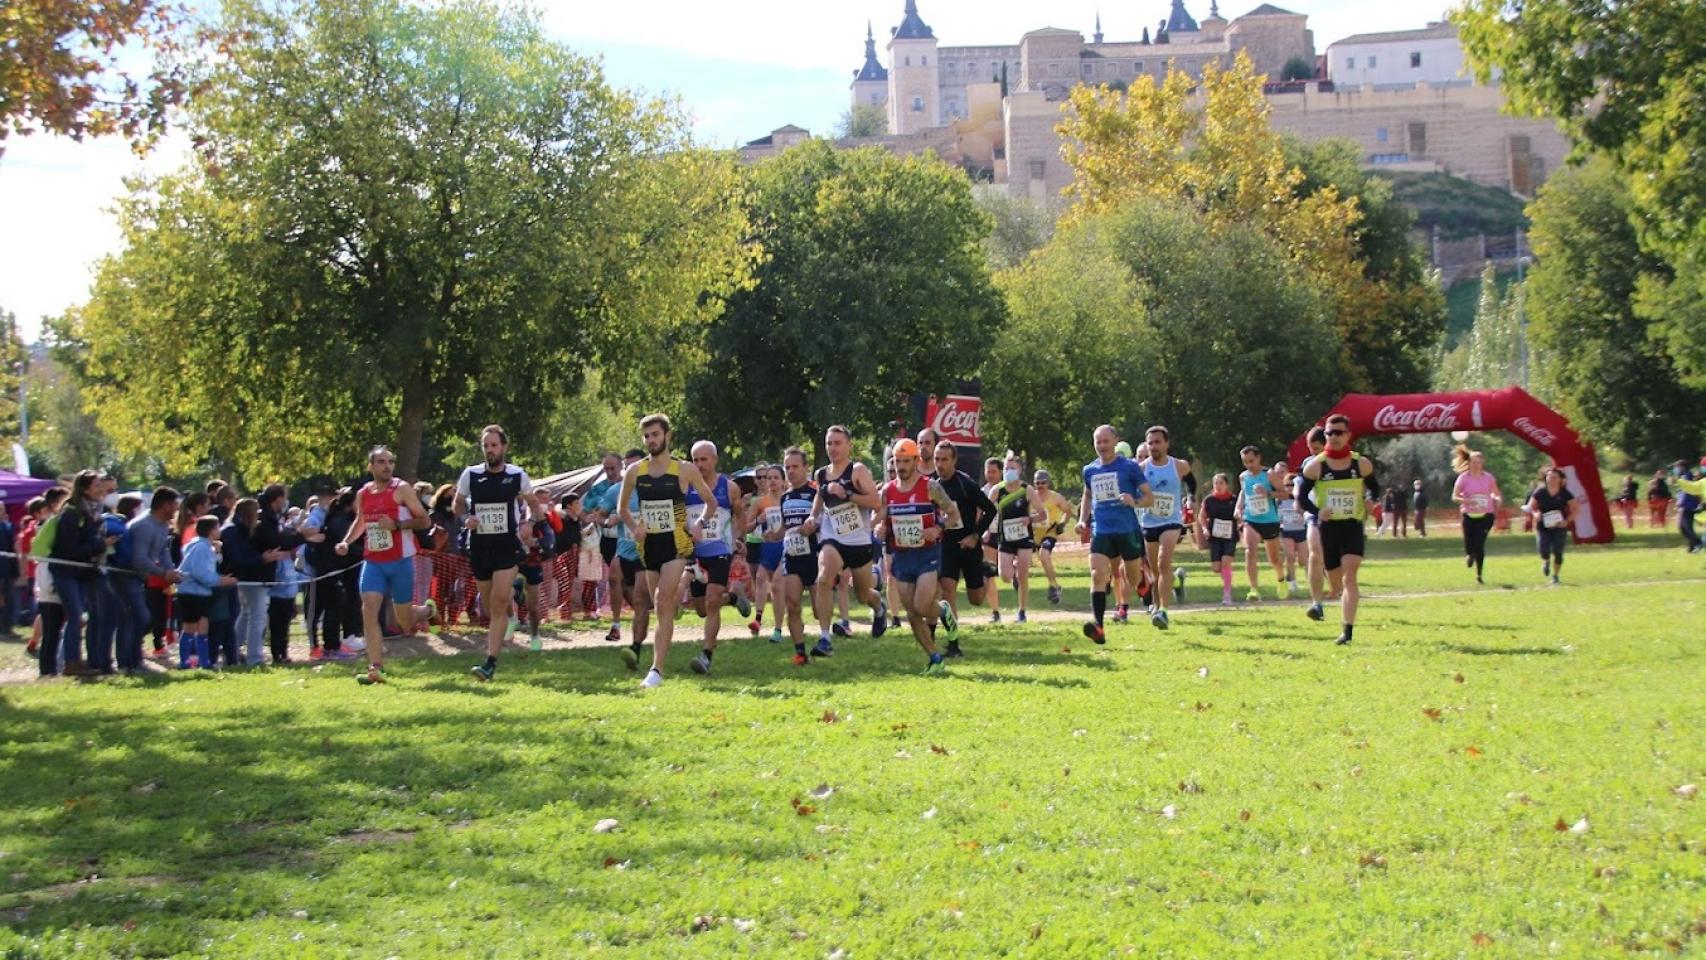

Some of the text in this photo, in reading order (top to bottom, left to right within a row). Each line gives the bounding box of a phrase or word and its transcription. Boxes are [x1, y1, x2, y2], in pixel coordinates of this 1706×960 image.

[1373, 402, 1459, 431] Coca-Cola
[1512, 416, 1557, 447] Coca-Cola
[1094, 481, 1115, 492] 1132
[1332, 498, 1354, 507] 1156
[480, 513, 504, 524] 1139
[647, 511, 670, 521] 1129
[835, 511, 858, 526] 1065
[659, 522, 671, 530] bk
[896, 527, 920, 537] 1142
